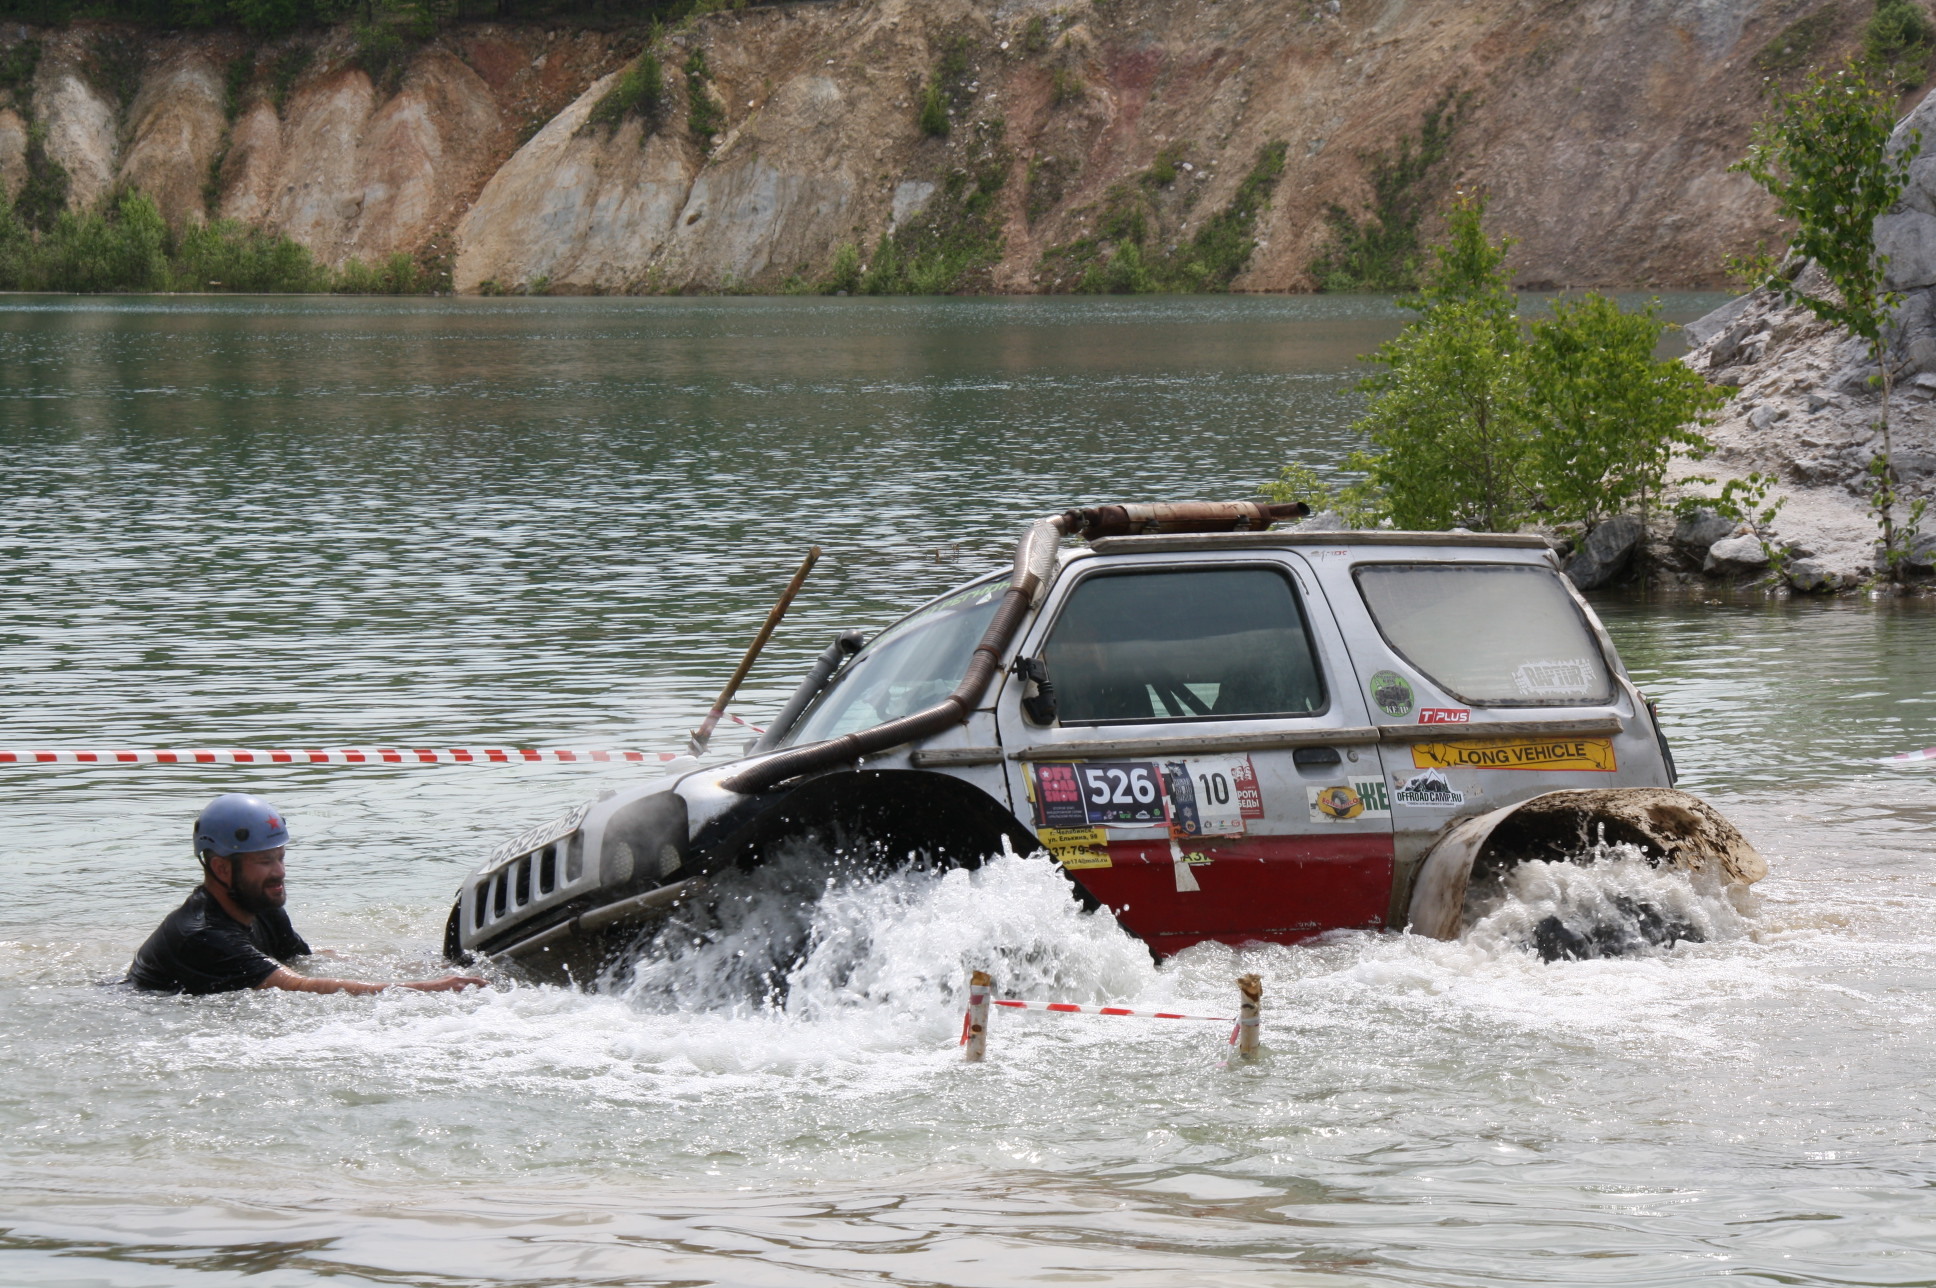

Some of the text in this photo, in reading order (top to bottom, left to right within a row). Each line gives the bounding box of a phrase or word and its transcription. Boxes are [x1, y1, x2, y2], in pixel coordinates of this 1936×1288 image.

[1523, 665, 1586, 687] RAPTOR
[1421, 711, 1469, 722] T PLUS
[1458, 743, 1586, 764] LONG VEHICLE
[1085, 768, 1155, 805] 526
[1199, 773, 1229, 805] 10
